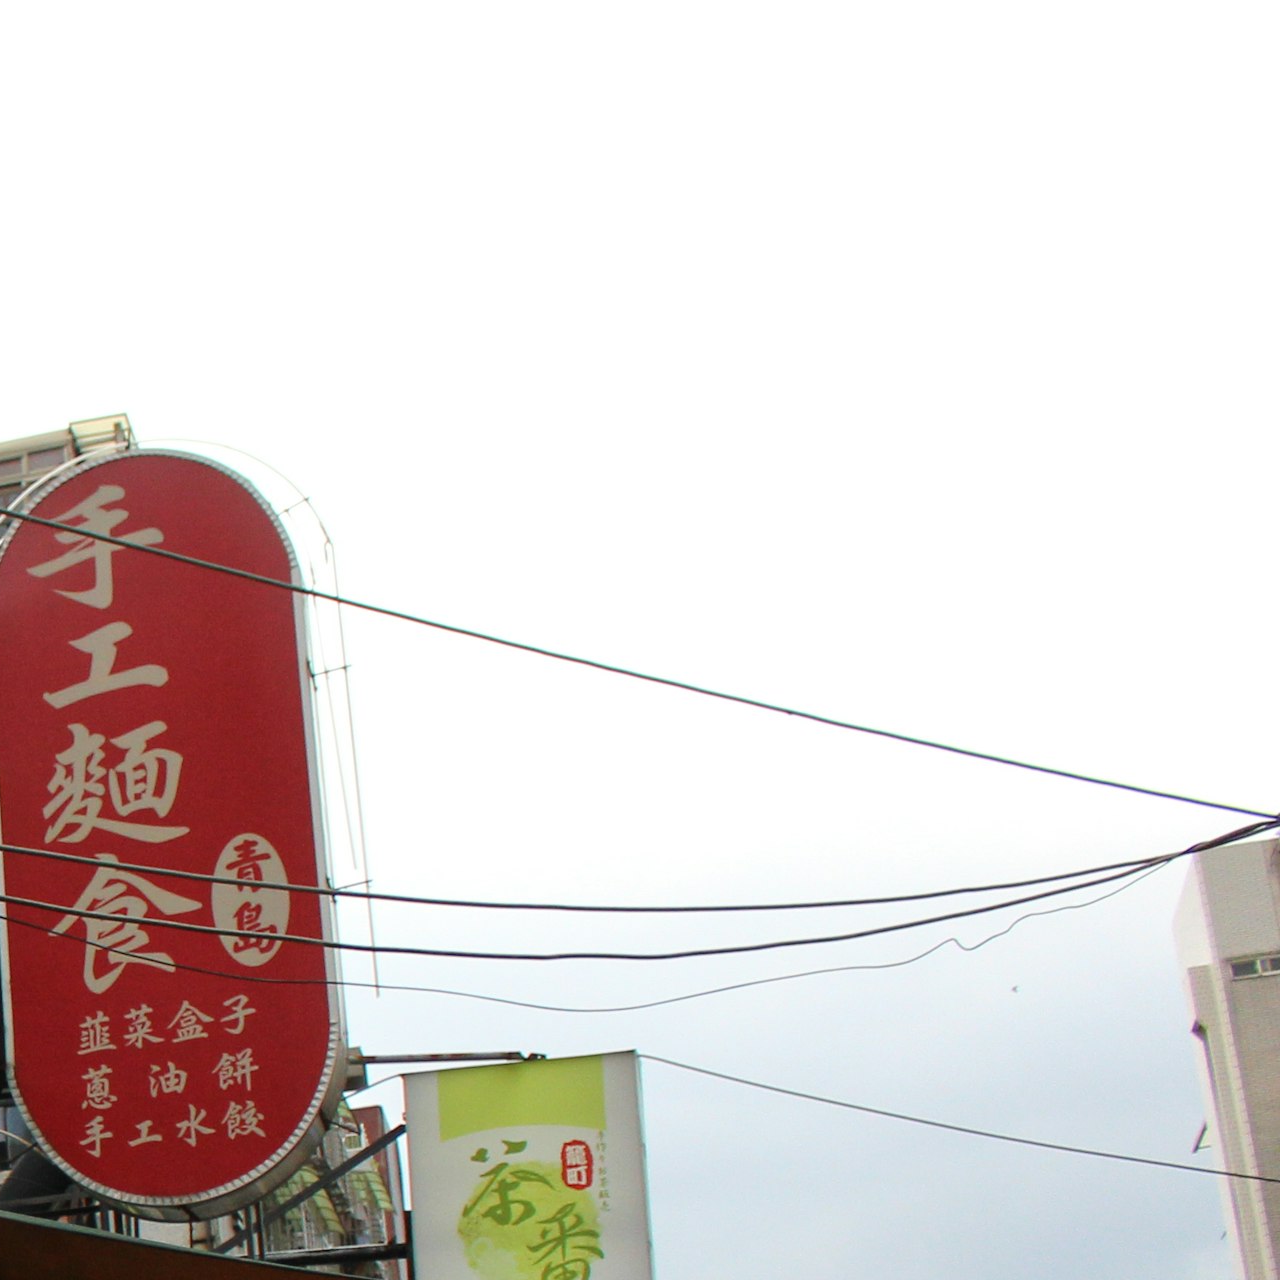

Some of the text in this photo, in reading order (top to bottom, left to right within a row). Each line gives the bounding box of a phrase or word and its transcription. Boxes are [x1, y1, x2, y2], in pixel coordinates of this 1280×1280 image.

[27, 483, 203, 994] 手工麵食
[222, 838, 280, 959] 青島
[79, 1101, 267, 1160] 手工水餃
